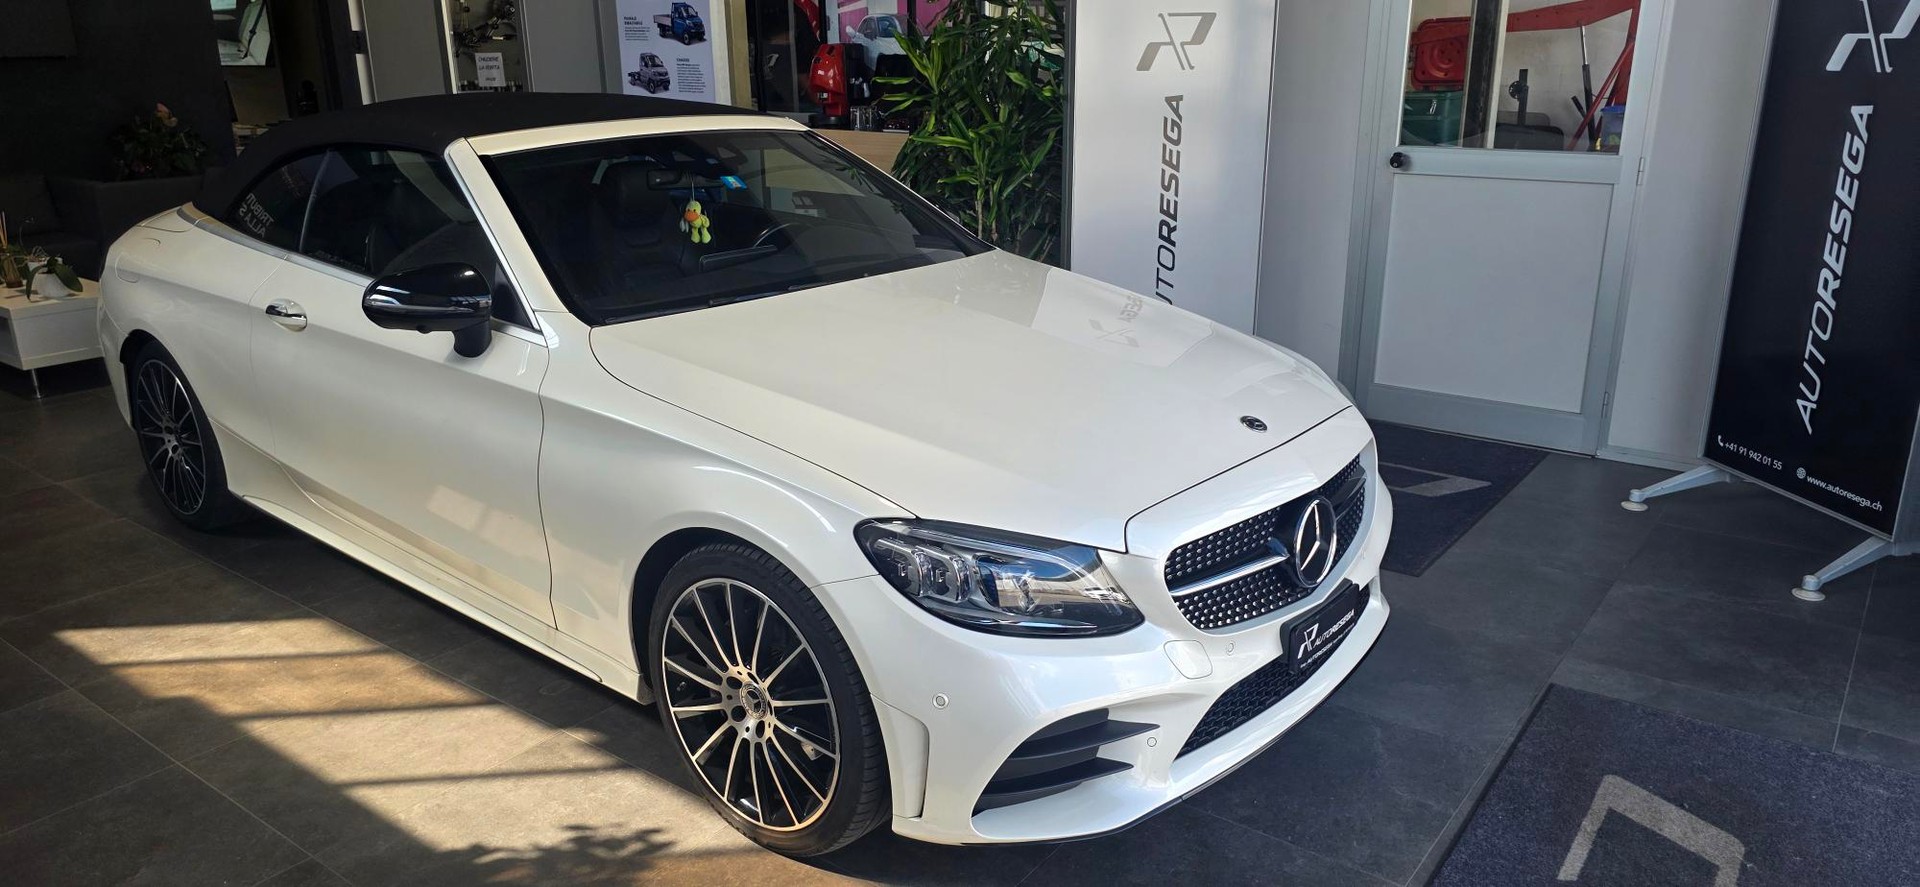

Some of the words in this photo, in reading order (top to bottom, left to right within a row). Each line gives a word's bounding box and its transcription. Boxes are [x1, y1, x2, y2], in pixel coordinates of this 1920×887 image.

[1155, 94, 1184, 305] TORESEGA
[1796, 105, 1874, 435] AUTORESEGA
[1725, 442, 1738, 452] +41
[1738, 446, 1748, 456] 91
[1748, 450, 1762, 462] 942
[1762, 455, 1771, 466] 01
[1772, 459, 1783, 470] 55
[1806, 475, 1883, 511] www.autoresega.ch
